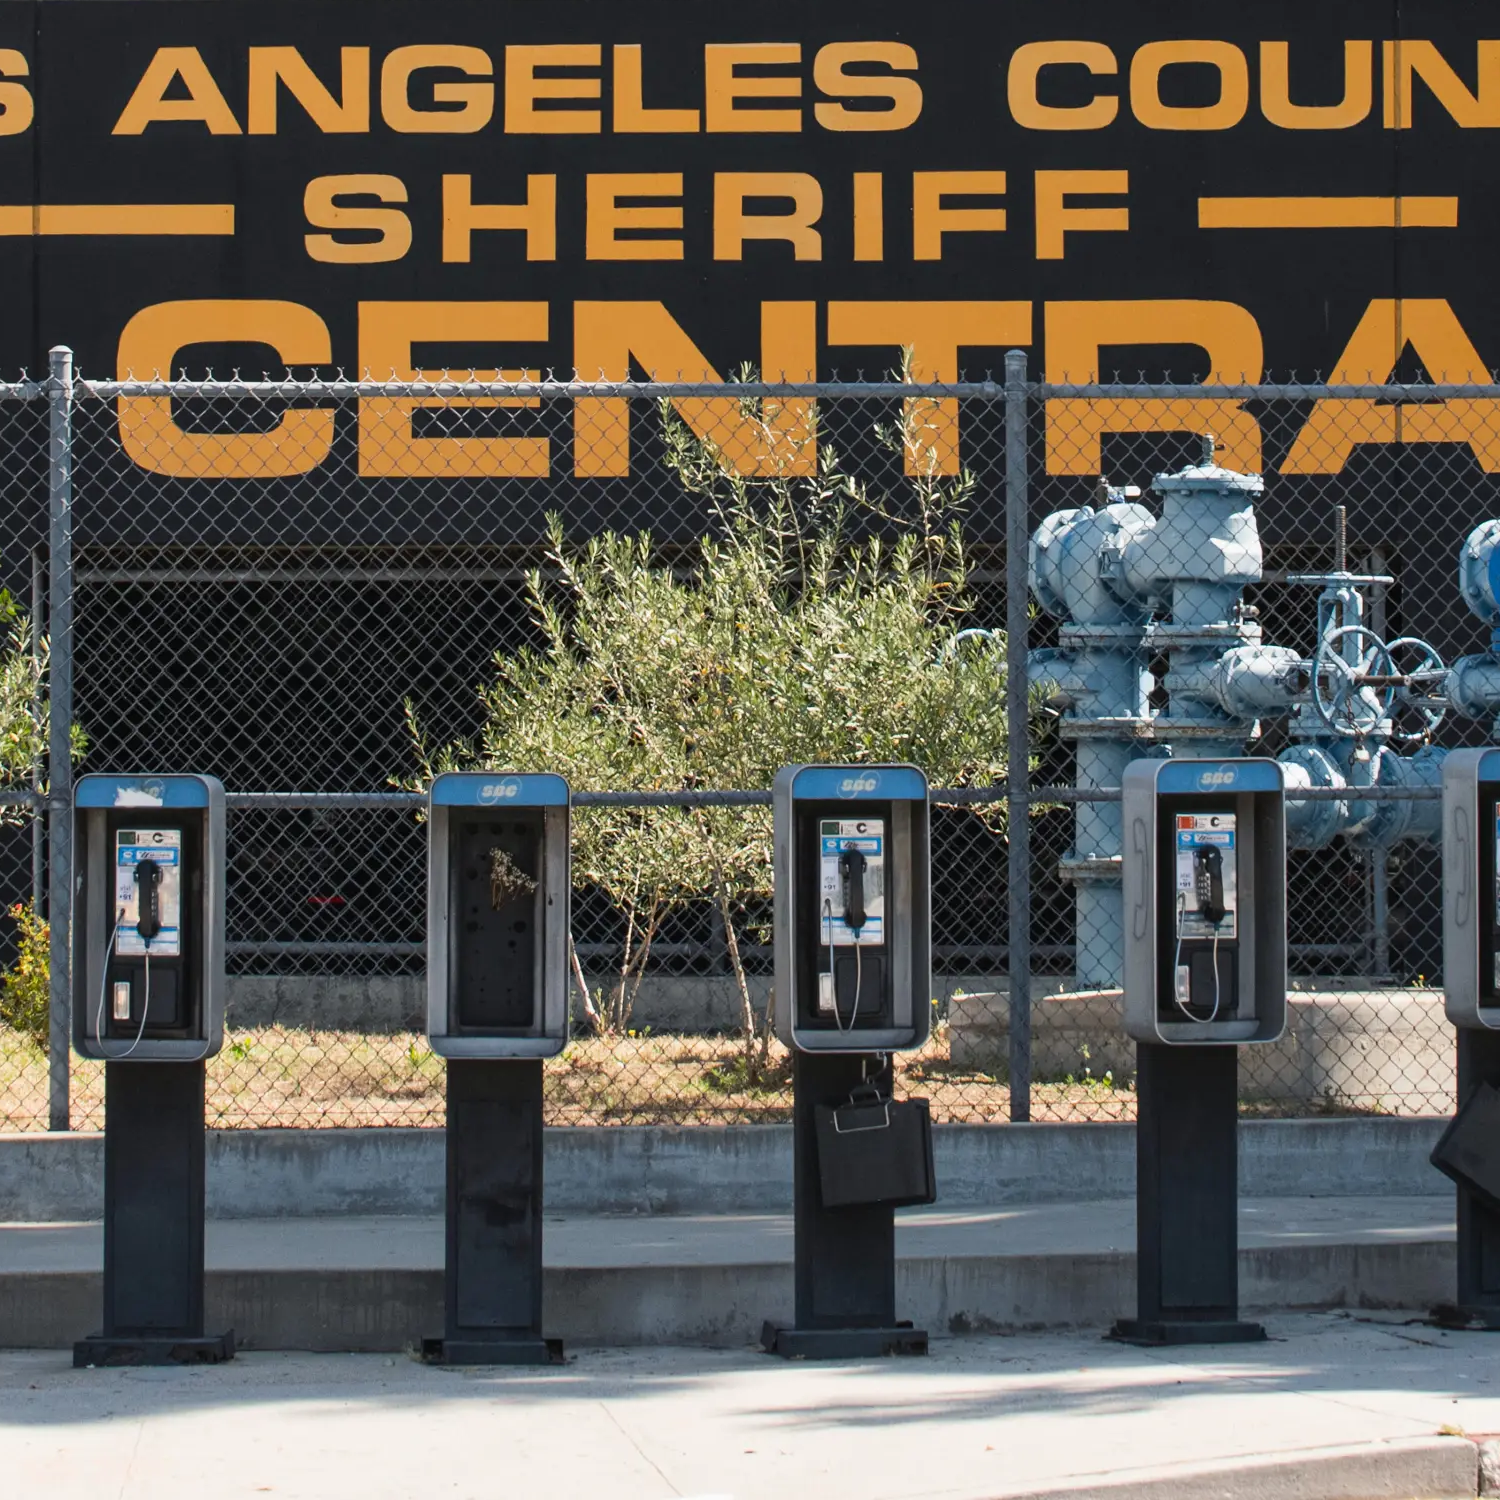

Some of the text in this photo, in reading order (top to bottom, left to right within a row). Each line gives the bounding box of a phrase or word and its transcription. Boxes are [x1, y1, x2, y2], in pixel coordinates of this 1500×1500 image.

[112, 41, 922, 135] ANGELES
[304, 170, 1128, 263] SHERIFF
[841, 779, 877, 791] SBC
[1200, 772, 1235, 785] SBC
[482, 785, 518, 797] SBC
